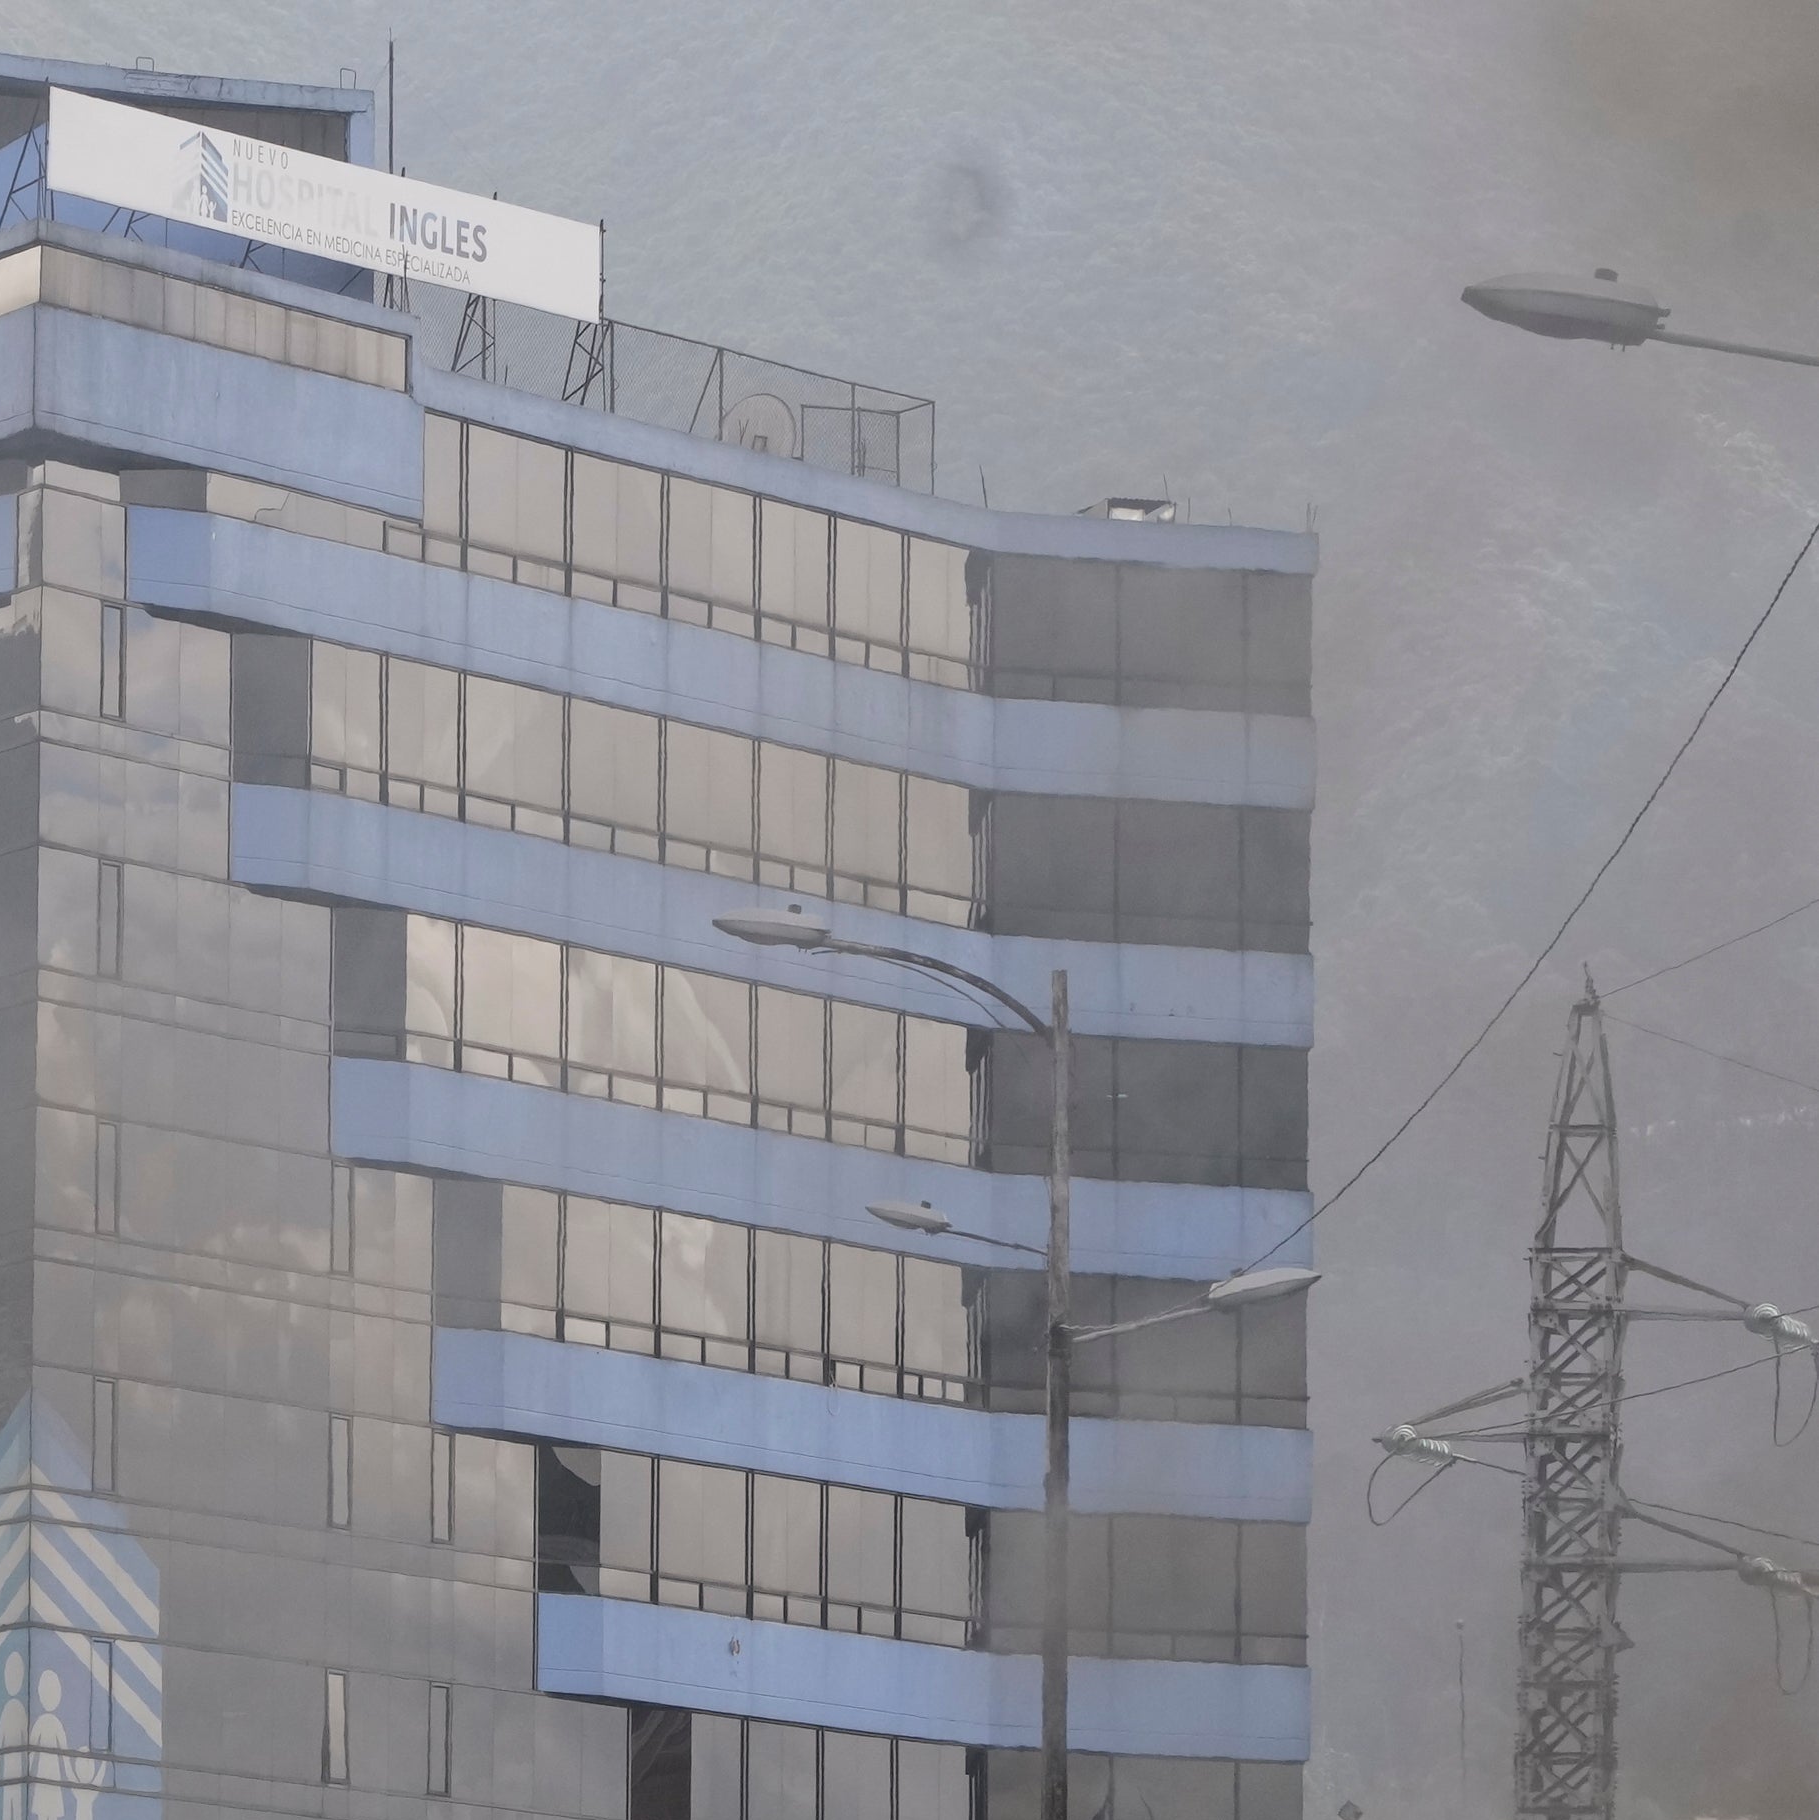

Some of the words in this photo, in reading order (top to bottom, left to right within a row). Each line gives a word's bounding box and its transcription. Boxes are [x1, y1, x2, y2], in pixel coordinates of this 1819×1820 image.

[232, 138, 290, 170] NUEVO
[231, 209, 304, 243] EXCELENCIA
[306, 228, 322, 246] EN
[324, 234, 382, 263] MEDICINA
[385, 249, 471, 285] ESPECIALIZADA
[389, 202, 488, 263] INGLES
